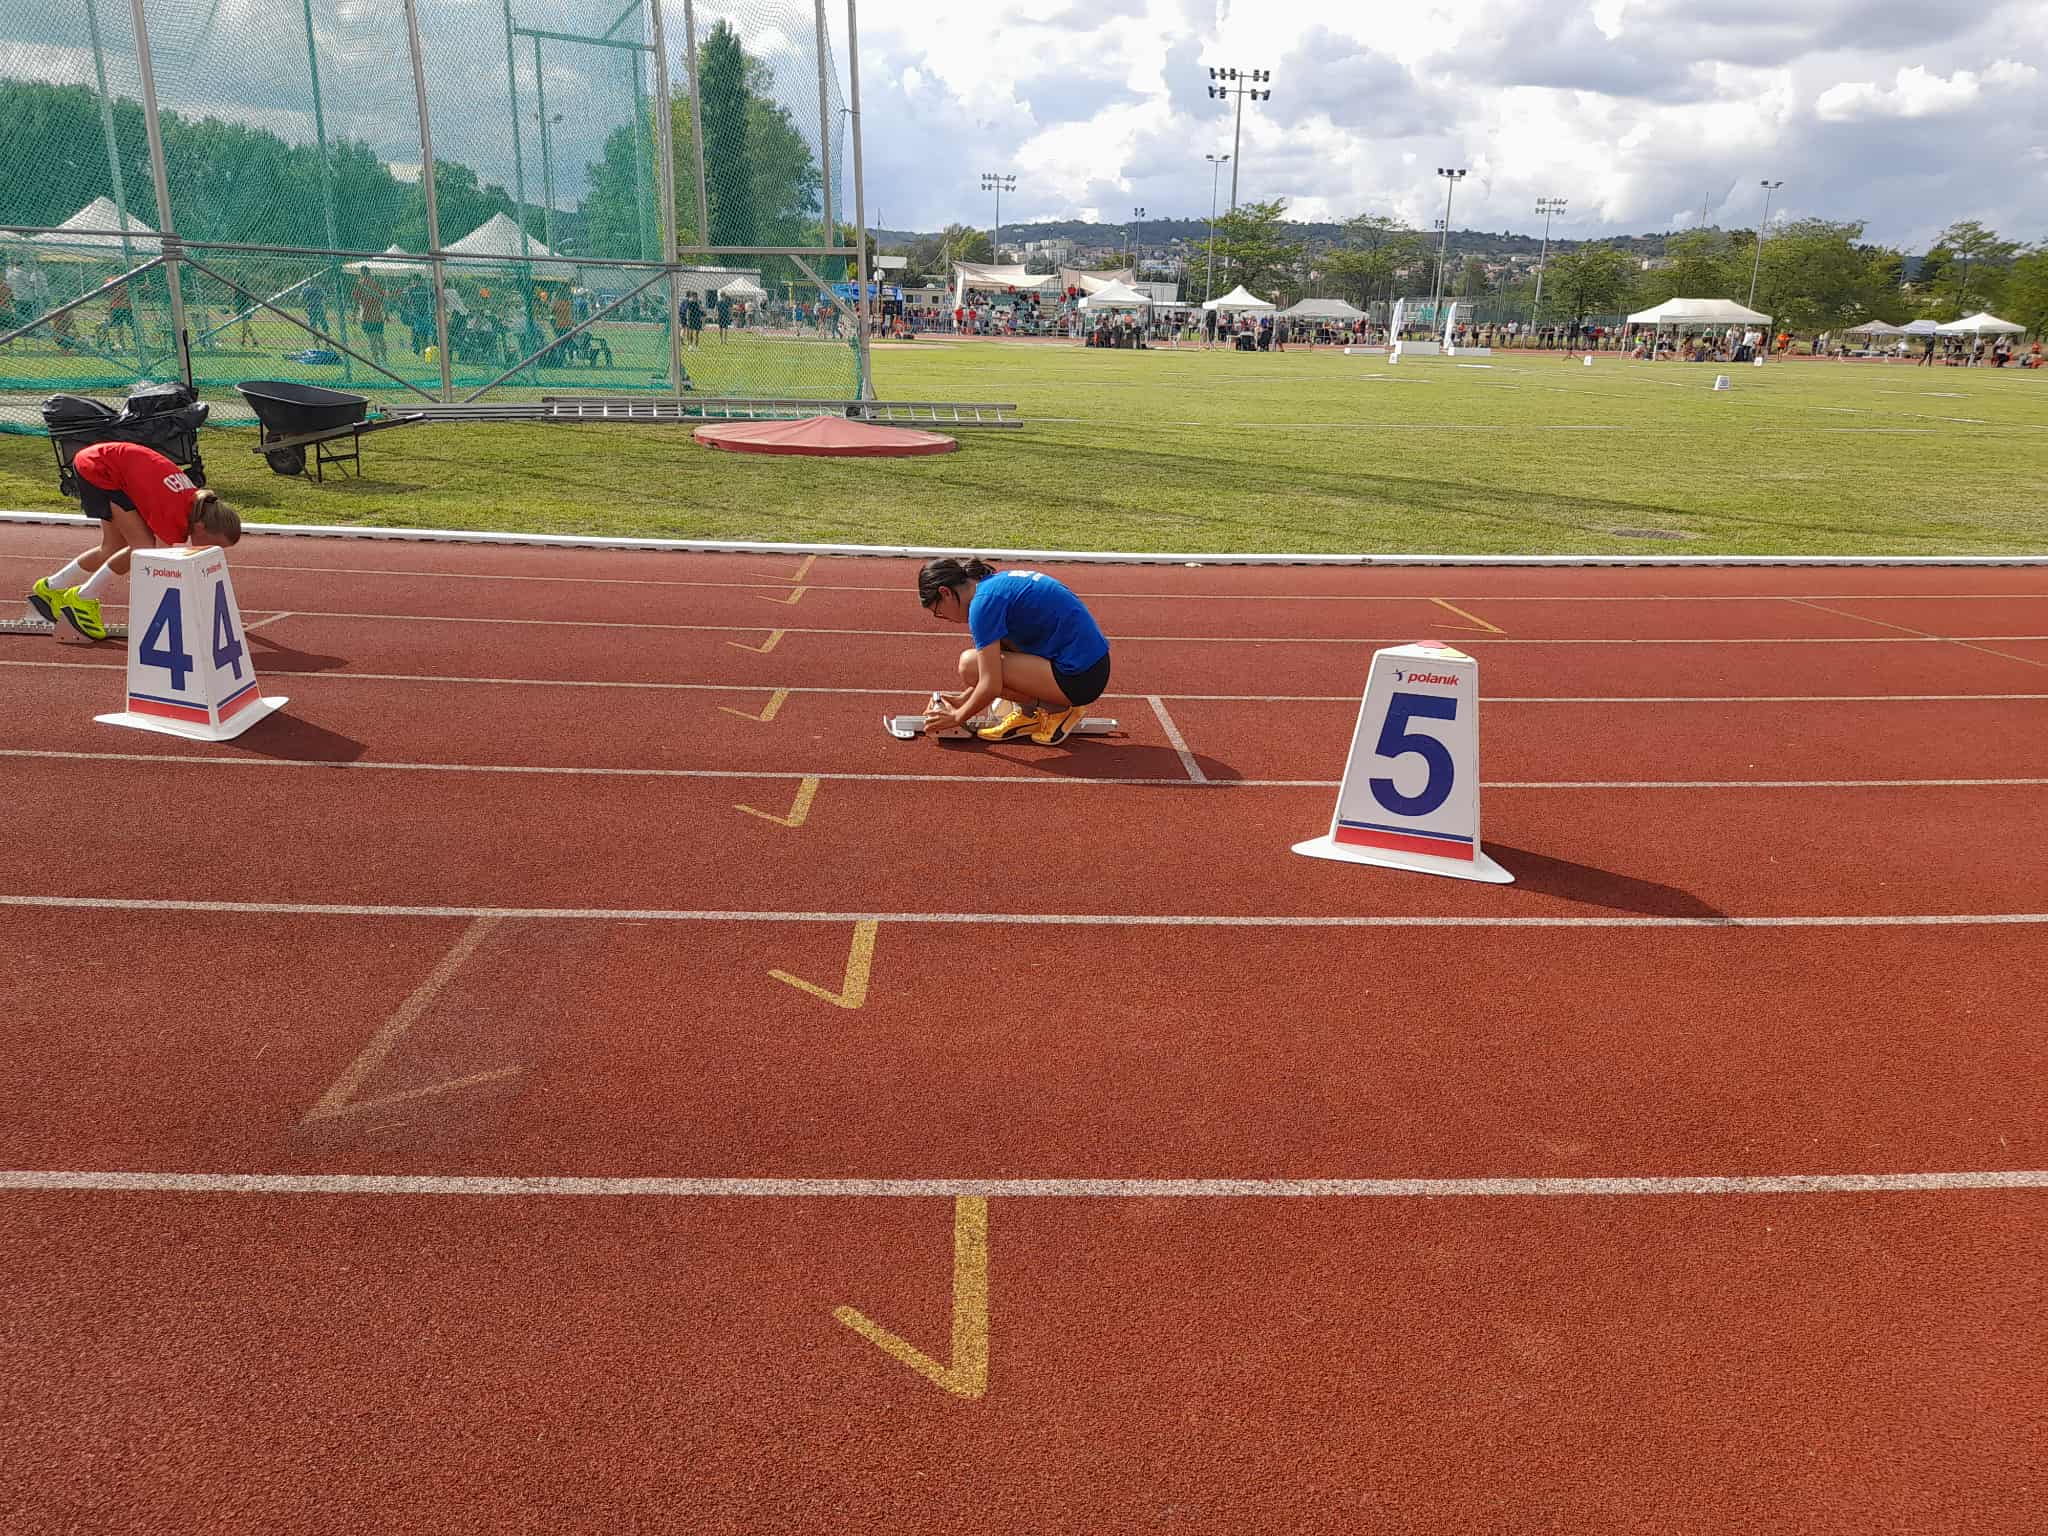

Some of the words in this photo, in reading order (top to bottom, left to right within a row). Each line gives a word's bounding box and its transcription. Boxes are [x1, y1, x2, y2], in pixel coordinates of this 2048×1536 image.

[139, 587, 194, 691] 4
[212, 580, 243, 681] 4
[1408, 672, 1460, 686] polanik
[1369, 692, 1458, 817] 5
